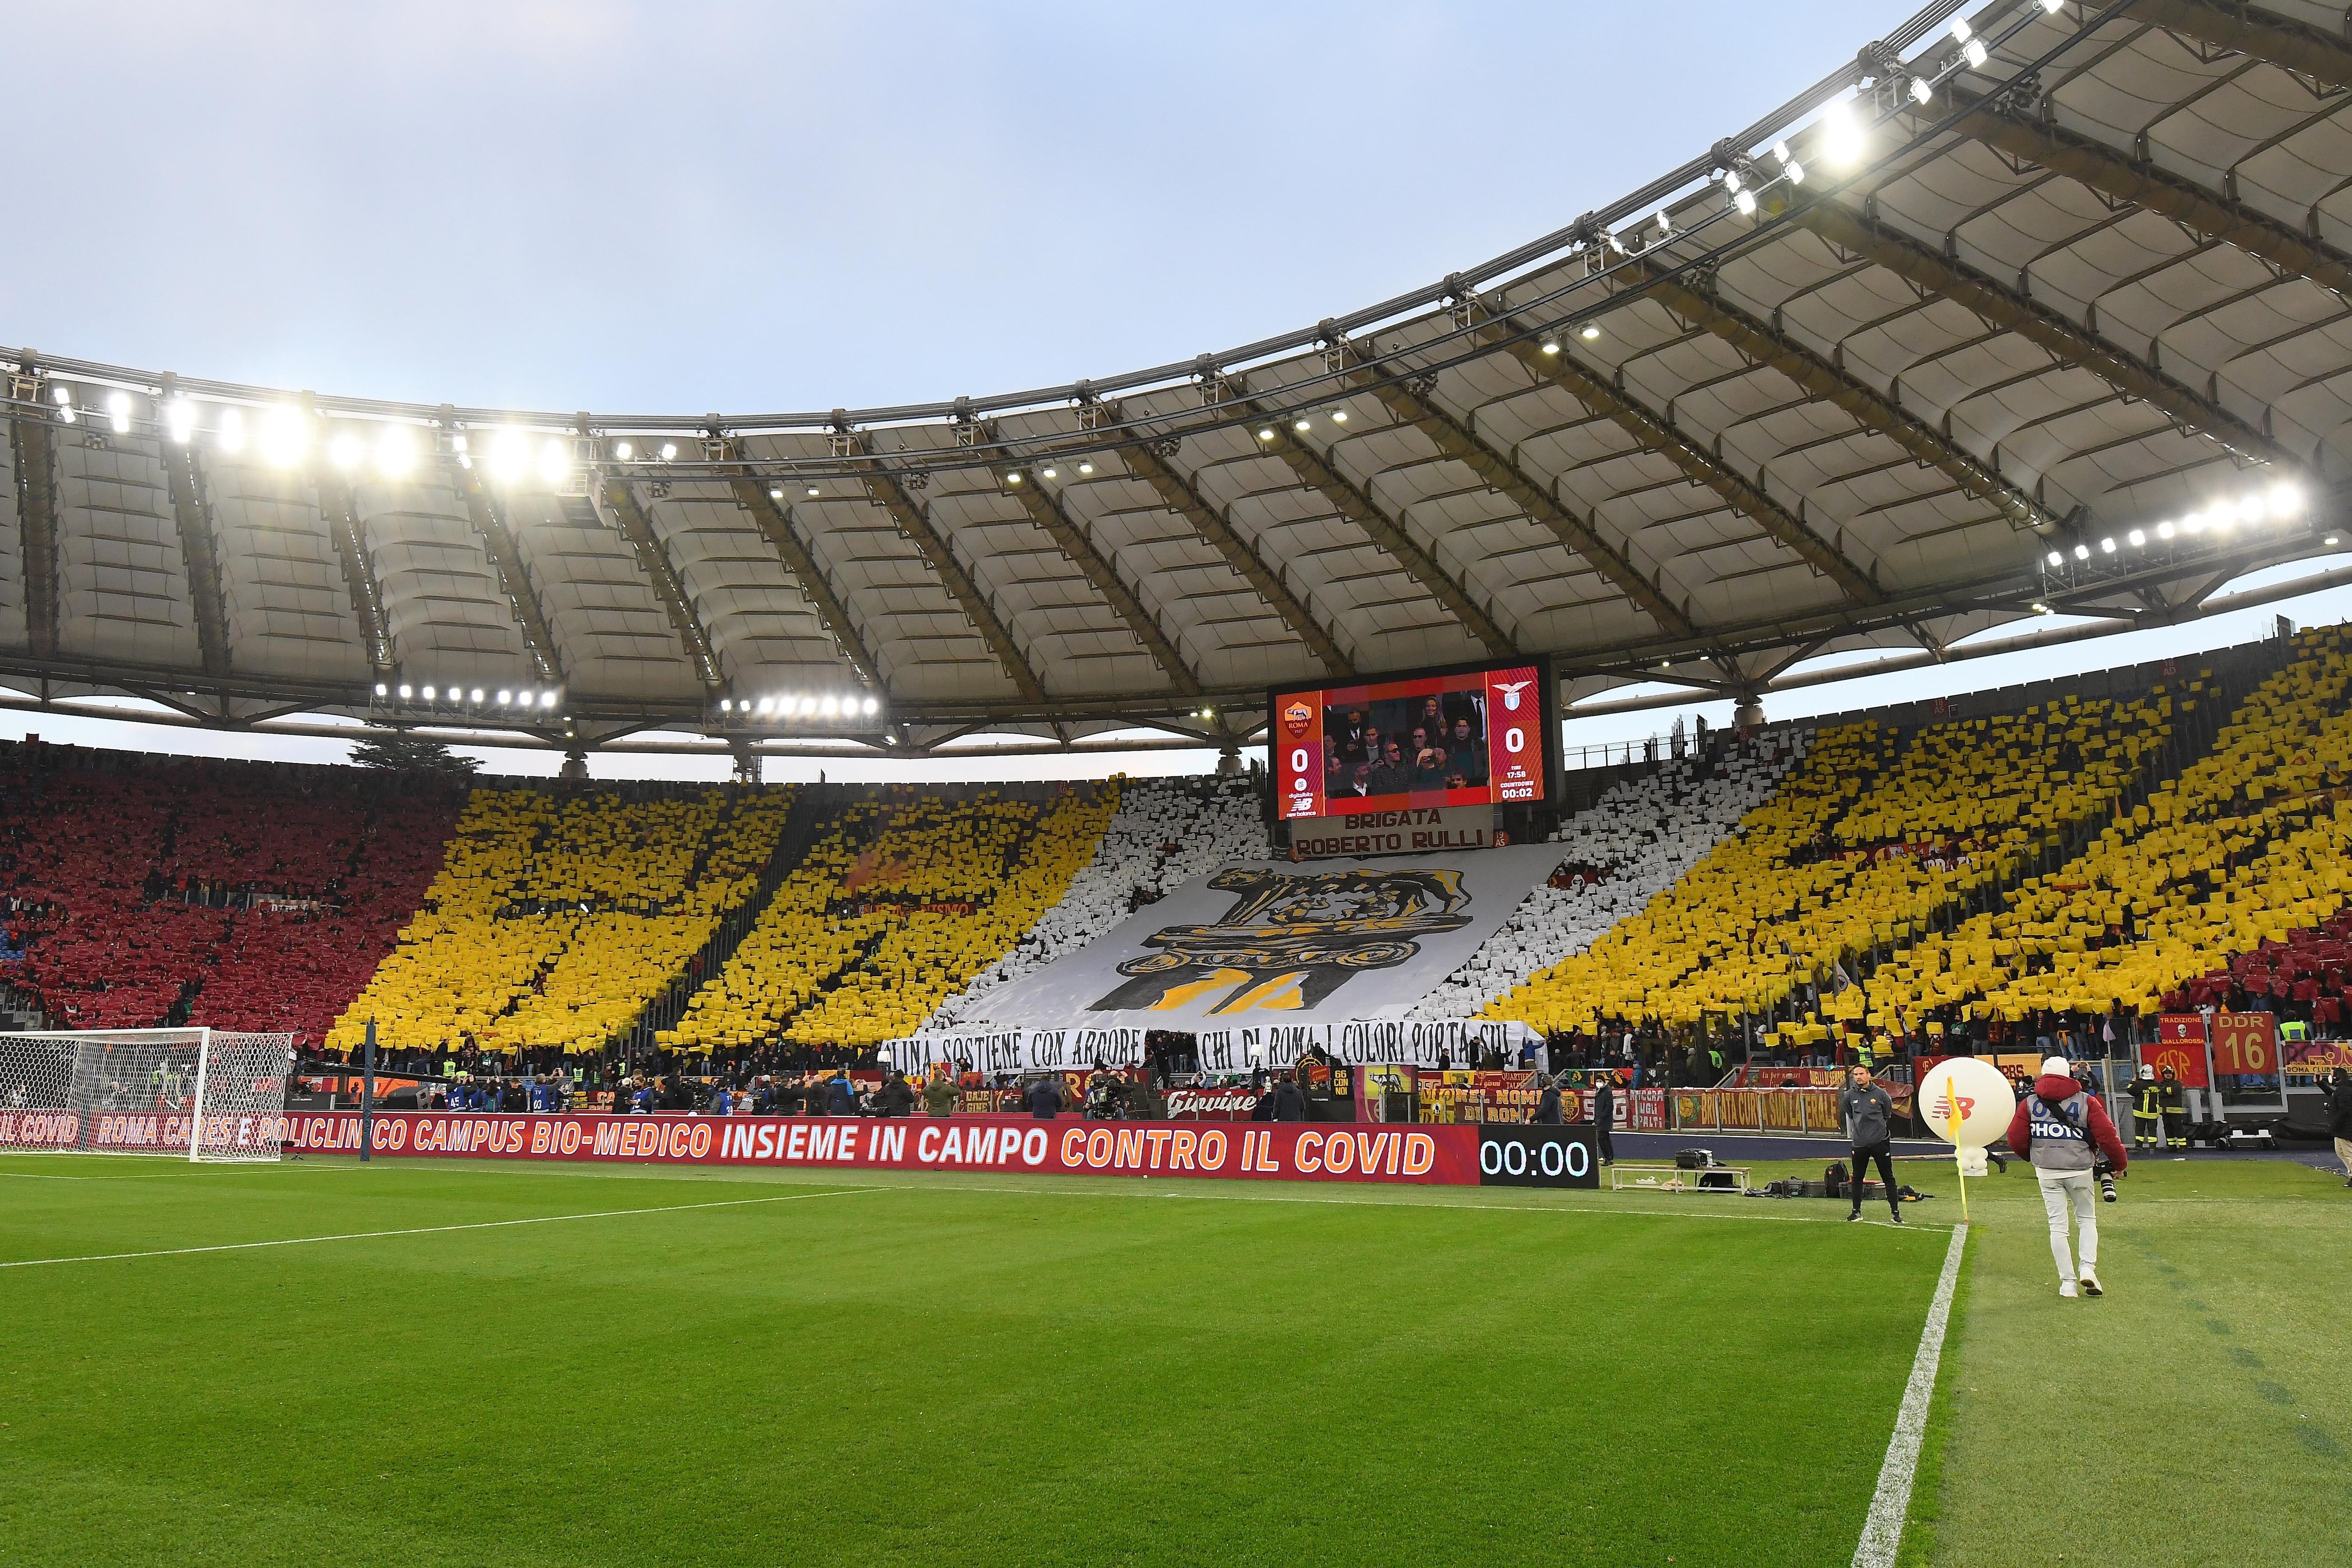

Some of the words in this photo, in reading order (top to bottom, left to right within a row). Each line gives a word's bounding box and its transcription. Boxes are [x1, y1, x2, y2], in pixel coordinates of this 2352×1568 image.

[1506, 728, 1524, 753] 0
[1292, 749, 1308, 772] 0
[1502, 788, 1533, 798] 00:02
[1345, 809, 1442, 829] BRIGATA
[1296, 833, 1401, 855] ROBERTO
[1412, 829, 1483, 848] RULLI
[2219, 1015, 2265, 1028] DDR
[944, 1031, 1022, 1072] SOSTIENE
[1032, 1031, 1066, 1066] CON
[1073, 1028, 1142, 1065] ARDORE
[1201, 1030, 1233, 1071] CHI
[1270, 1026, 1313, 1065] ROMA
[1327, 1025, 1332, 1055] I
[1343, 1021, 1405, 1063] COLORI
[1412, 1021, 1470, 1063] PORTA
[2225, 1032, 2265, 1069] 16
[1770, 1072, 1780, 1081] per
[1810, 1070, 1824, 1085] QUELLI
[966, 1090, 989, 1101] DAJE
[1335, 1087, 1348, 1095] NOI
[1456, 1089, 1490, 1104] NEL
[450, 1097, 460, 1108] 45
[534, 1099, 542, 1110] 03
[1769, 1093, 1787, 1126] SUD
[2032, 1099, 2080, 1122] 04
[1464, 1106, 1481, 1121] DI
[1487, 1107, 1537, 1123] ROMA
[2030, 1122, 2083, 1139] PHOTO
[21, 1115, 79, 1143] COVID
[99, 1116, 156, 1145] ROMA
[238, 1118, 253, 1145] E
[413, 1119, 525, 1153] CAMPUS
[531, 1121, 711, 1158] BIO-MEDICO
[720, 1124, 859, 1161] INSIEME
[868, 1126, 907, 1162] IN
[917, 1125, 1048, 1167] CAMPO
[1061, 1127, 1227, 1170] CONTRO
[1241, 1130, 1279, 1172] IL
[1295, 1130, 1436, 1176] COVID
[1480, 1140, 1589, 1177] 00:00
